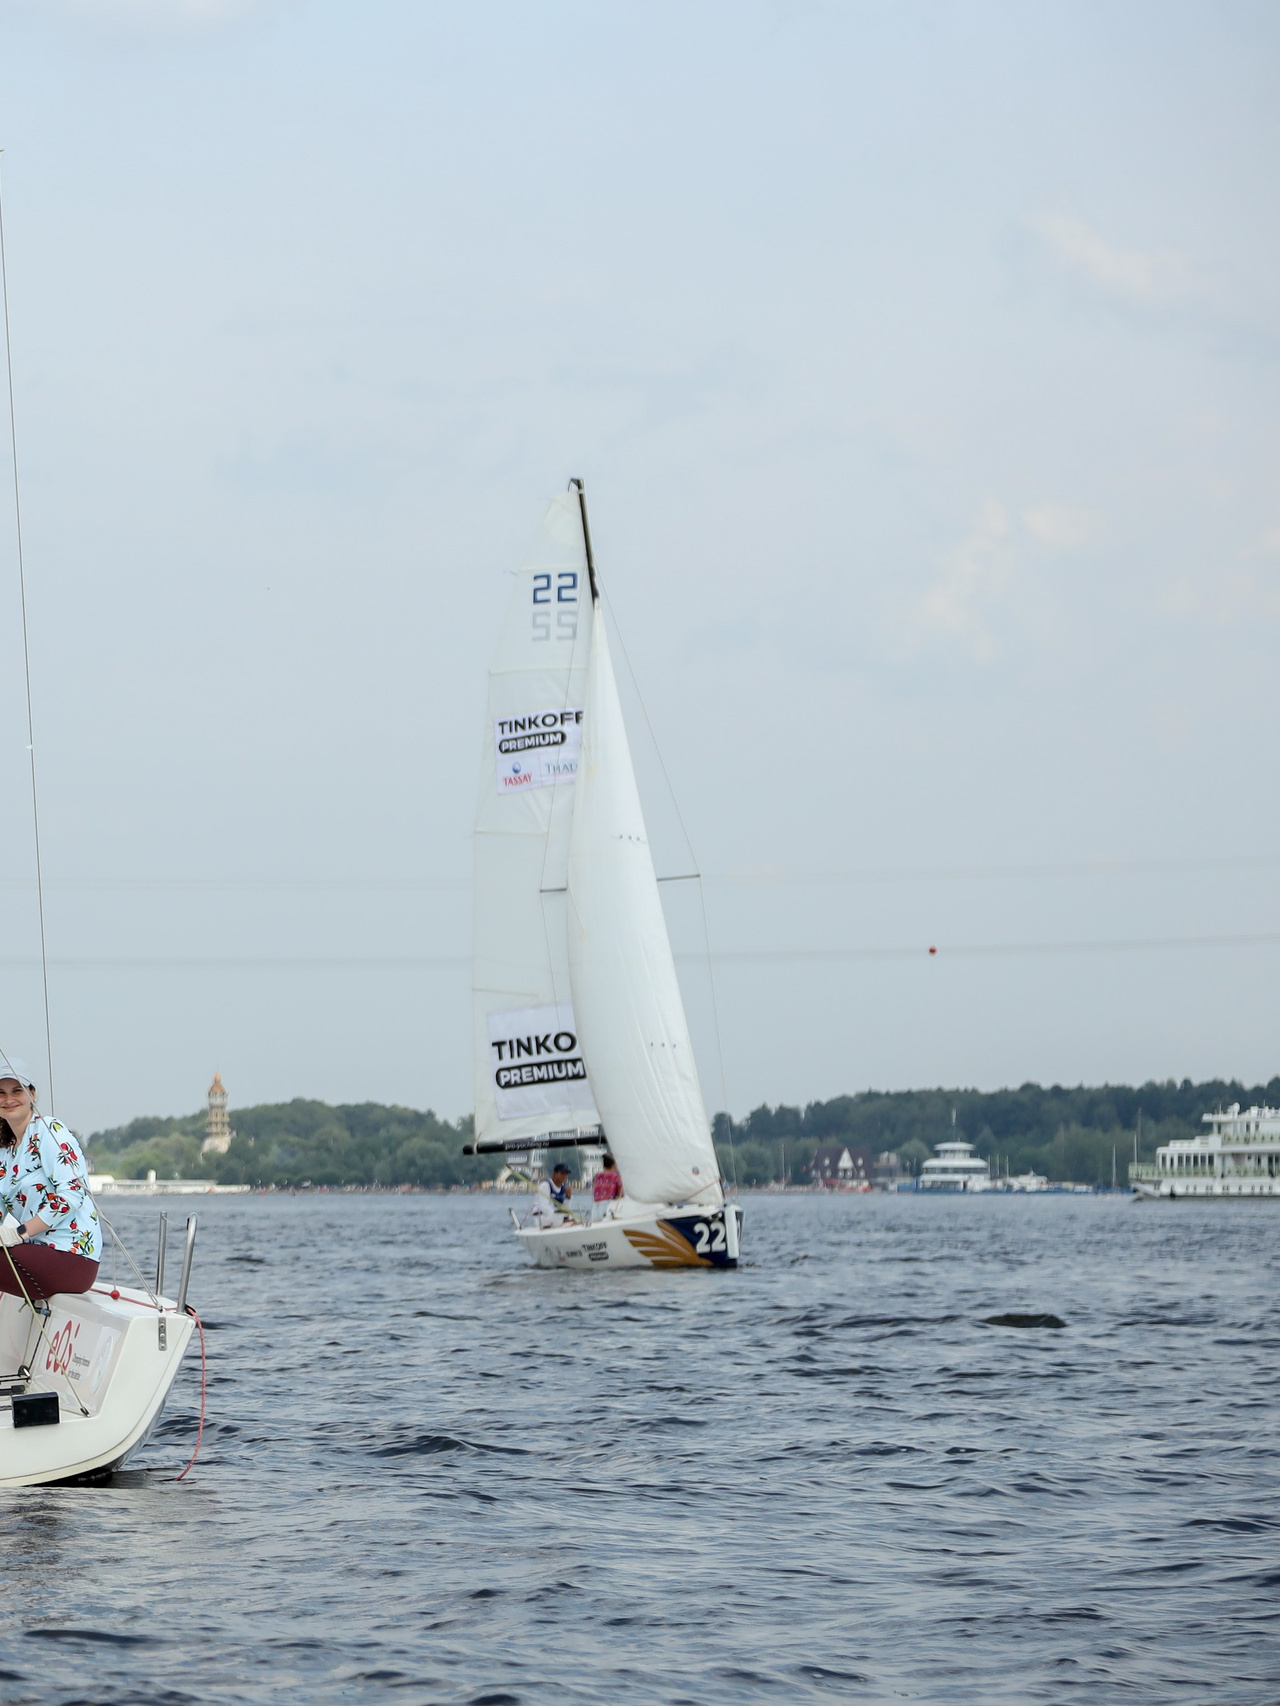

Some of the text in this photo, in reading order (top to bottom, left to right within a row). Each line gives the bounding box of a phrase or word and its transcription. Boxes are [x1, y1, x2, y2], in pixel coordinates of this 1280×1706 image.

[532, 572, 578, 604] 22
[498, 711, 583, 735] TINKOFF
[501, 732, 563, 752] PREMIUM
[491, 1031, 577, 1061] TINKO
[499, 1061, 585, 1087] PREMIUM
[694, 1220, 727, 1254] 22
